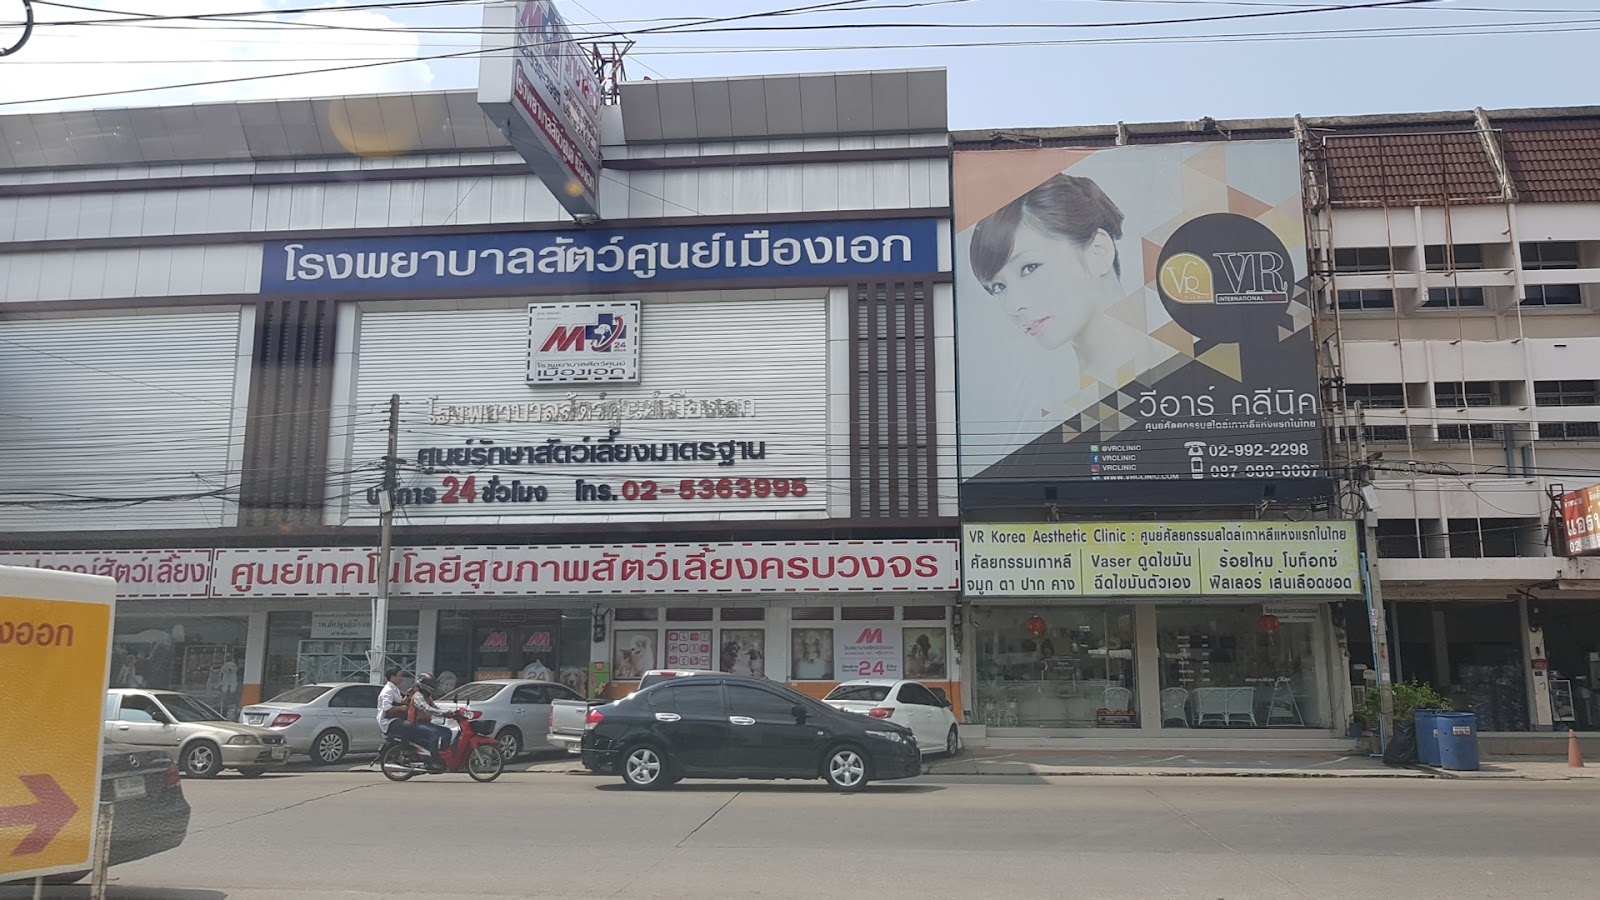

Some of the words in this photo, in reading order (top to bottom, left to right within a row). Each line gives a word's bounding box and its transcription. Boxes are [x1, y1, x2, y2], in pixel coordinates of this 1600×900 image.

[284, 231, 913, 281] โรงพยาบาลสัตว์ศูนย์เมืองเอก
[1213, 251, 1288, 294] VR
[613, 341, 627, 349] 24
[1139, 386, 1215, 417] วีอาร์
[1101, 445, 1142, 453] @VRCLINIC
[1209, 443, 1309, 457] 02-992-2298
[1102, 454, 1136, 463] VRCLINIC
[1102, 464, 1137, 472] VRCLINIC
[441, 476, 477, 503] 24
[482, 475, 548, 503] ชั่วโมง
[575, 479, 618, 501] โทร.
[622, 477, 808, 501] 02-5363995
[969, 530, 984, 543] VR
[992, 530, 1026, 543] Korea
[1033, 529, 1087, 543] Aesthetic
[1094, 528, 1126, 543] Clinic
[971, 554, 1072, 569] ศัลยกรรมเกาหลี
[1091, 555, 1132, 568] Vaser
[1138, 551, 1192, 571] ดูดไขมัน
[1219, 549, 1273, 568] ร้อยไหม
[1283, 550, 1338, 568] โบท็อกซ์
[967, 579, 993, 595] จมูก
[1000, 579, 1015, 591] ตา
[1021, 577, 1045, 591] ปาก
[1051, 579, 1075, 591] คาง
[1094, 574, 1191, 590] ฉีดไขมันตัวเอง
[1210, 572, 1262, 589] ฟิลเลอร์
[1269, 570, 1352, 589] เส้นเลือดขอด
[859, 660, 885, 676] 24
